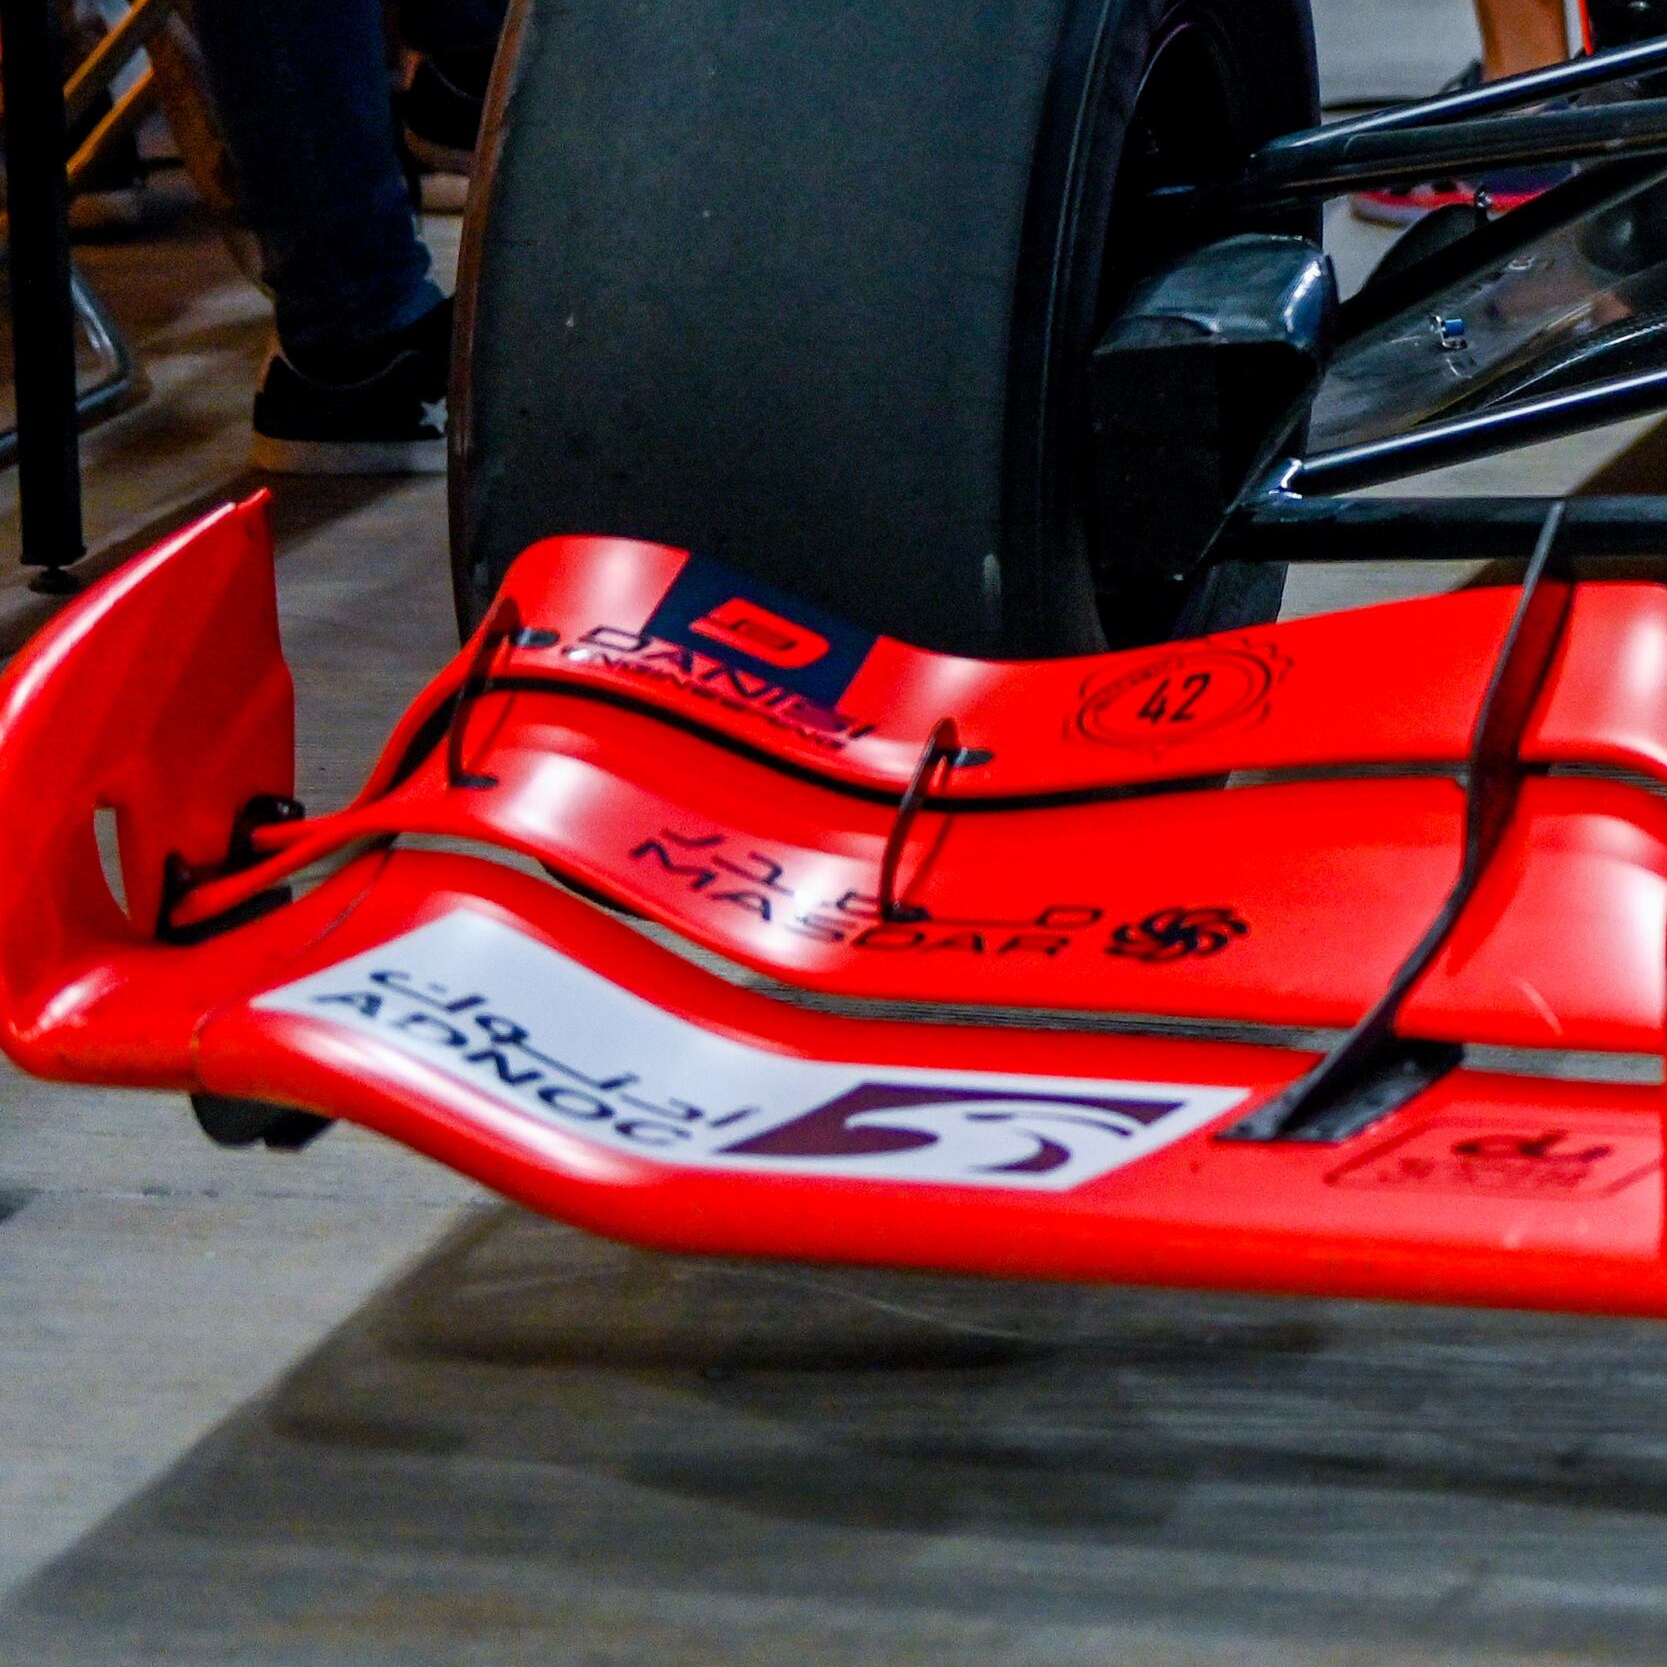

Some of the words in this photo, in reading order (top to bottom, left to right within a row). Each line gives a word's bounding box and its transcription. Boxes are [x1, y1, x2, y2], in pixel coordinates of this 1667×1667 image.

[1136, 672, 1211, 723] 42
[630, 840, 1072, 957] MASDAR
[310, 990, 695, 1148] ADNOC
